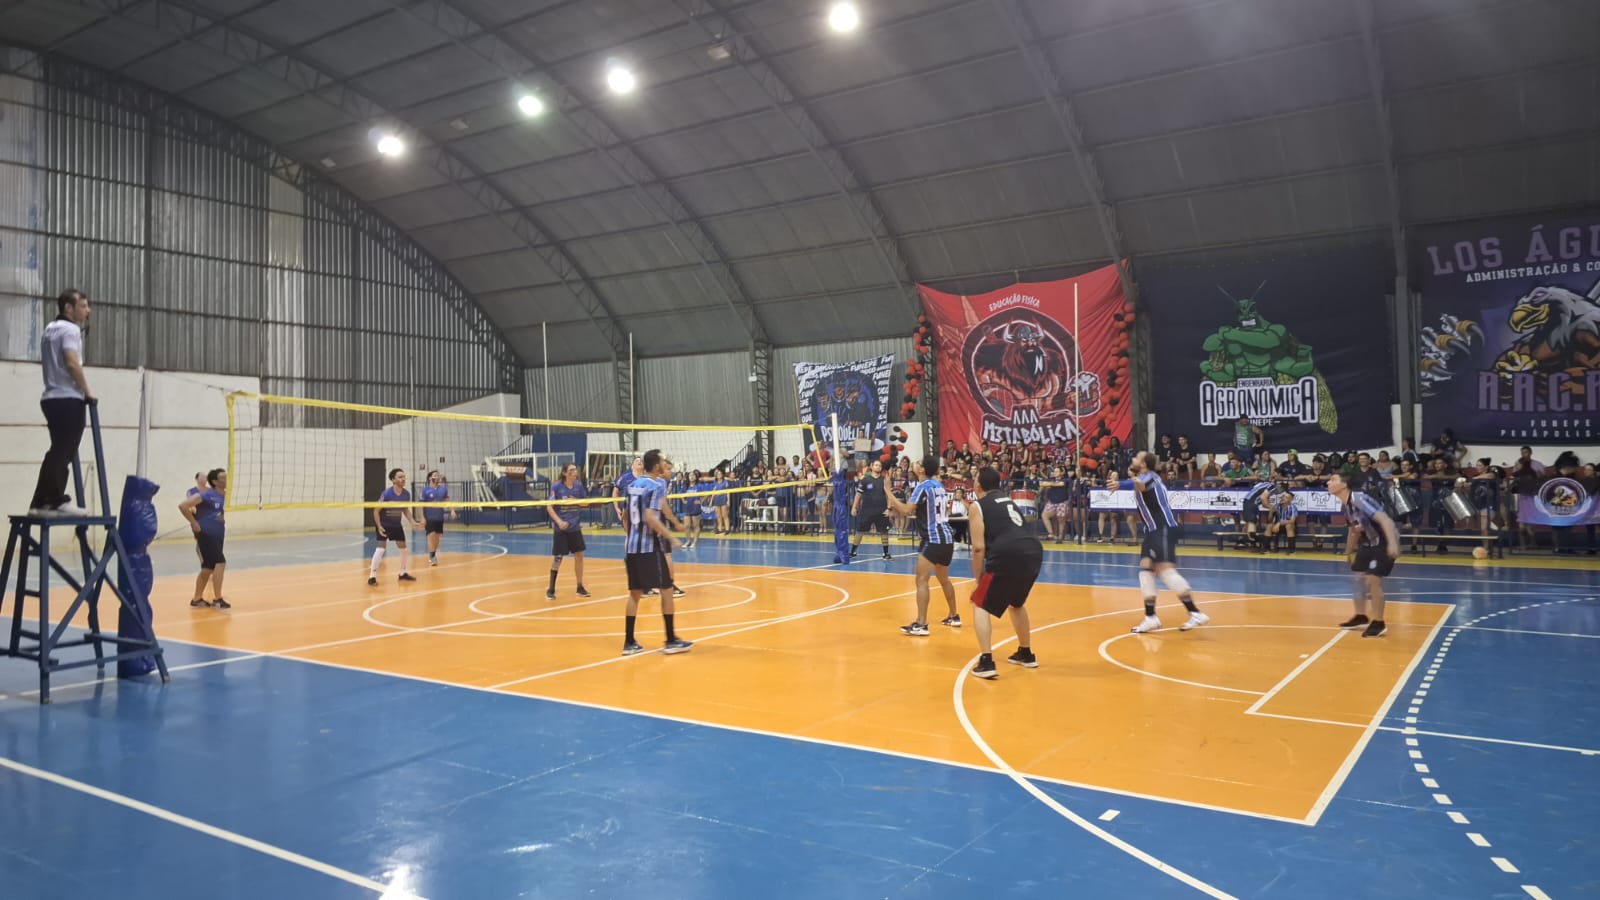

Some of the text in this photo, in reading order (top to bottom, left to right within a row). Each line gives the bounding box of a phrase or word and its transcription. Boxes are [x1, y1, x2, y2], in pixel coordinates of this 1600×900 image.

[1427, 237, 1503, 275] LOS
[1466, 263, 1568, 282] ADMINISTRAÇÃO
[1573, 262, 1580, 272] &
[988, 293, 1021, 312] EDUCAÇÃO
